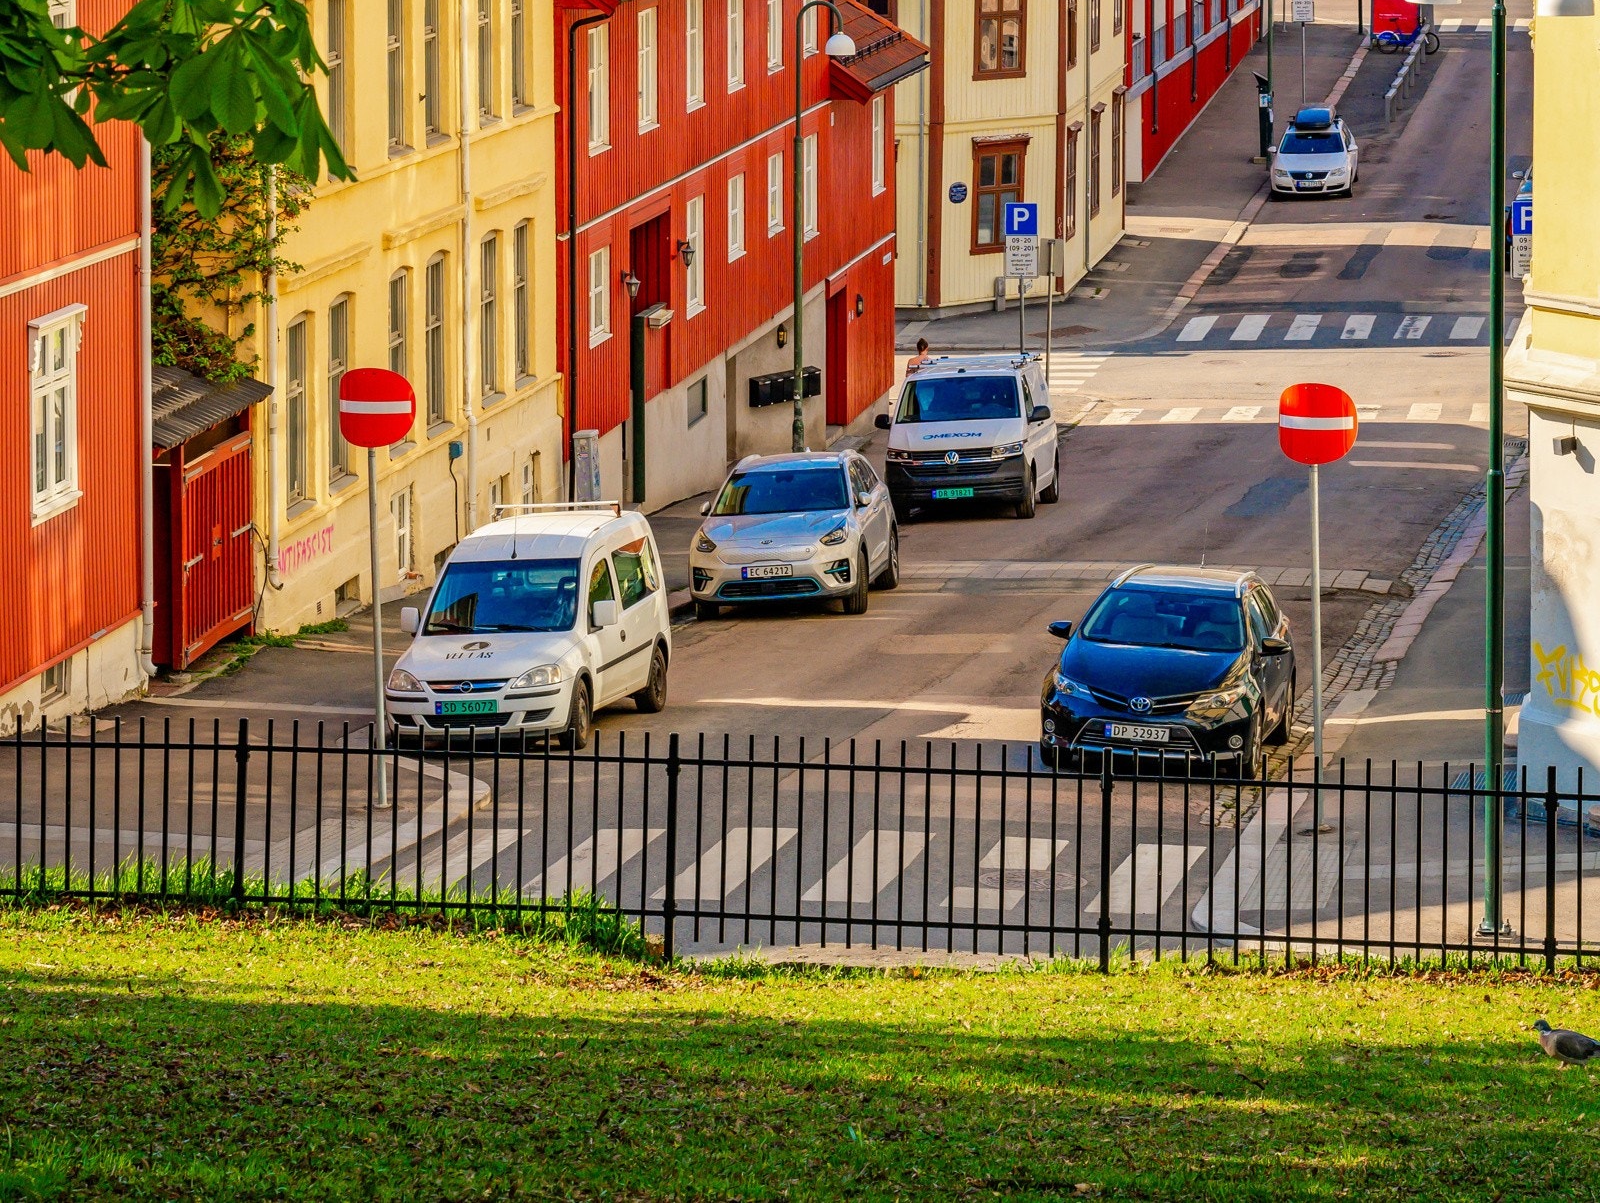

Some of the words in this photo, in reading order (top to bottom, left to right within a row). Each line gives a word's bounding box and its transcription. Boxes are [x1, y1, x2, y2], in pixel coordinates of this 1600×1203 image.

[1013, 207, 1030, 231] P
[922, 432, 982, 440] OMEXOM
[749, 568, 760, 577] EC
[763, 567, 789, 576] 64212
[443, 702, 457, 713] SD
[461, 701, 494, 712] 56072
[1113, 725, 1128, 736] DP
[1132, 727, 1167, 740] 52937
